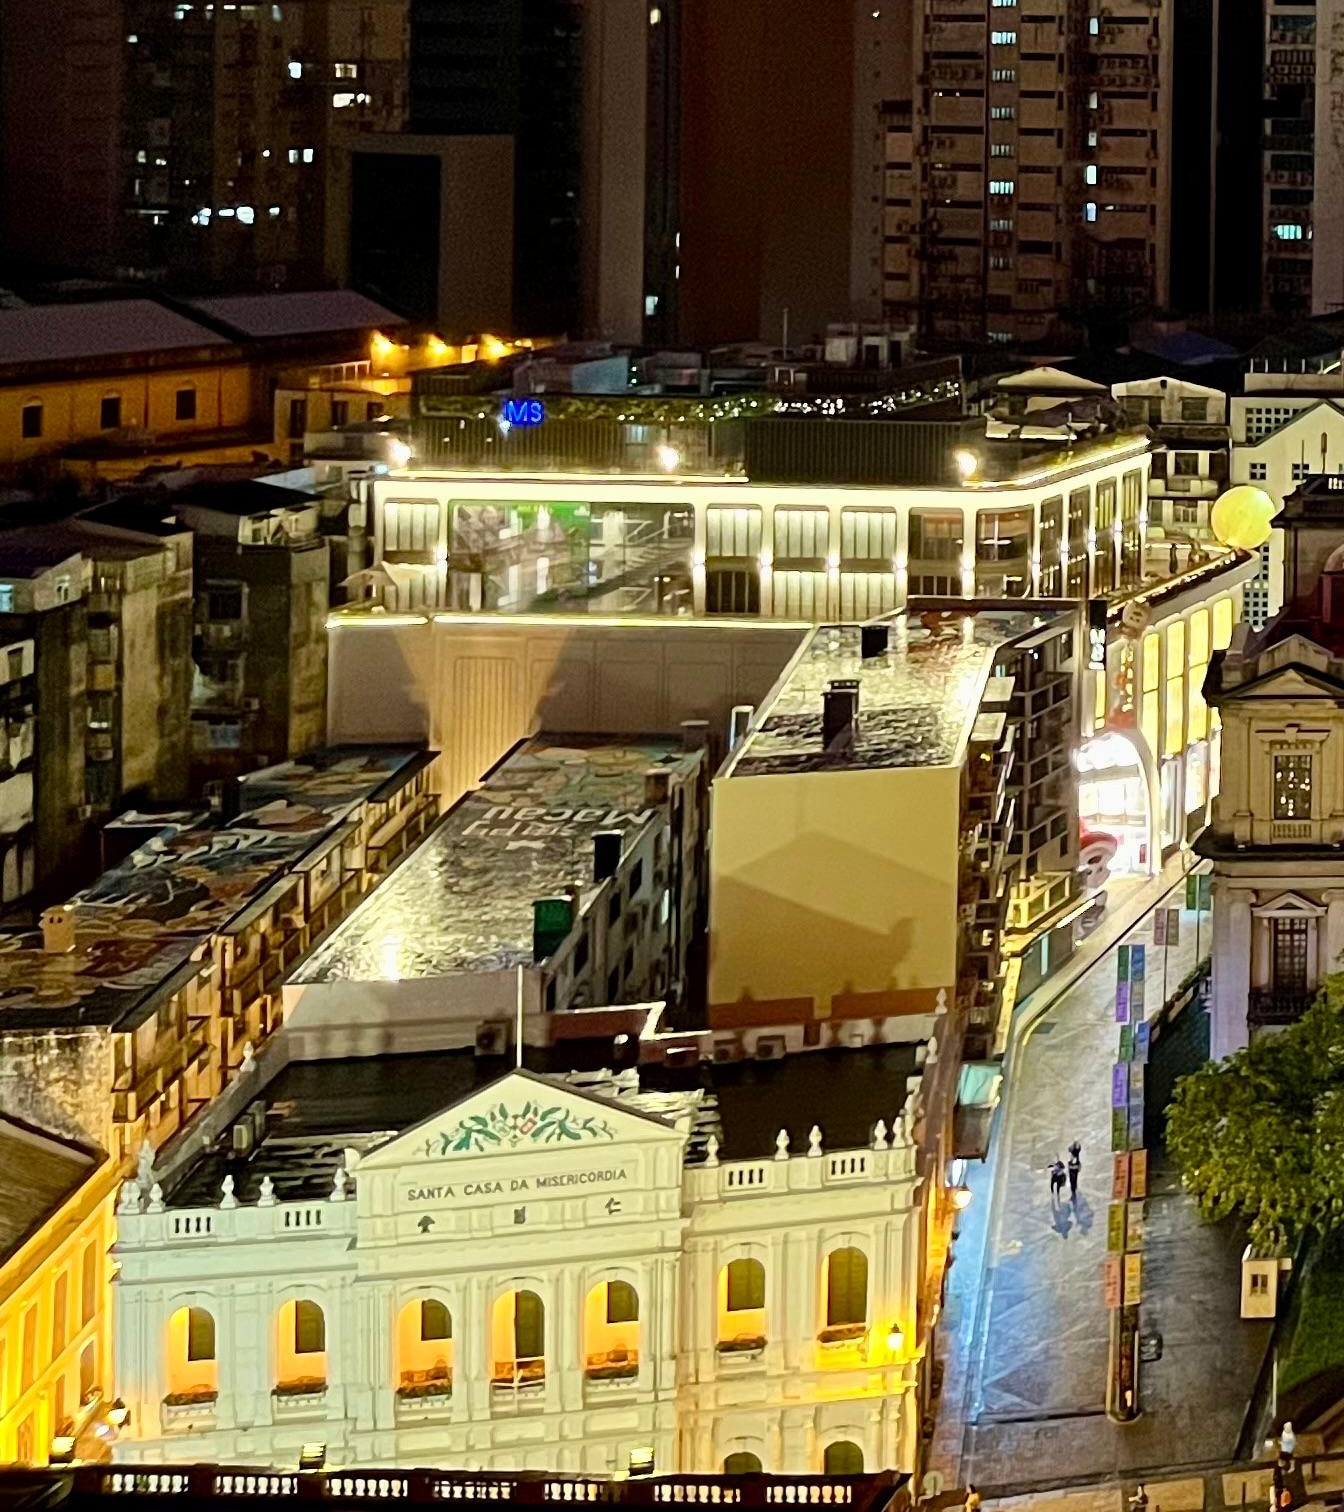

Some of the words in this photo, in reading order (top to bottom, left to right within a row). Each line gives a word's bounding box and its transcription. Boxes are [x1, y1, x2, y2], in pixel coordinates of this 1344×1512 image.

[482, 806, 655, 825] Macau
[407, 1186, 455, 1201] SANTA
[463, 1181, 504, 1196] CASA
[510, 1179, 529, 1192] DA
[536, 1168, 628, 1188] MISERICORDIA
